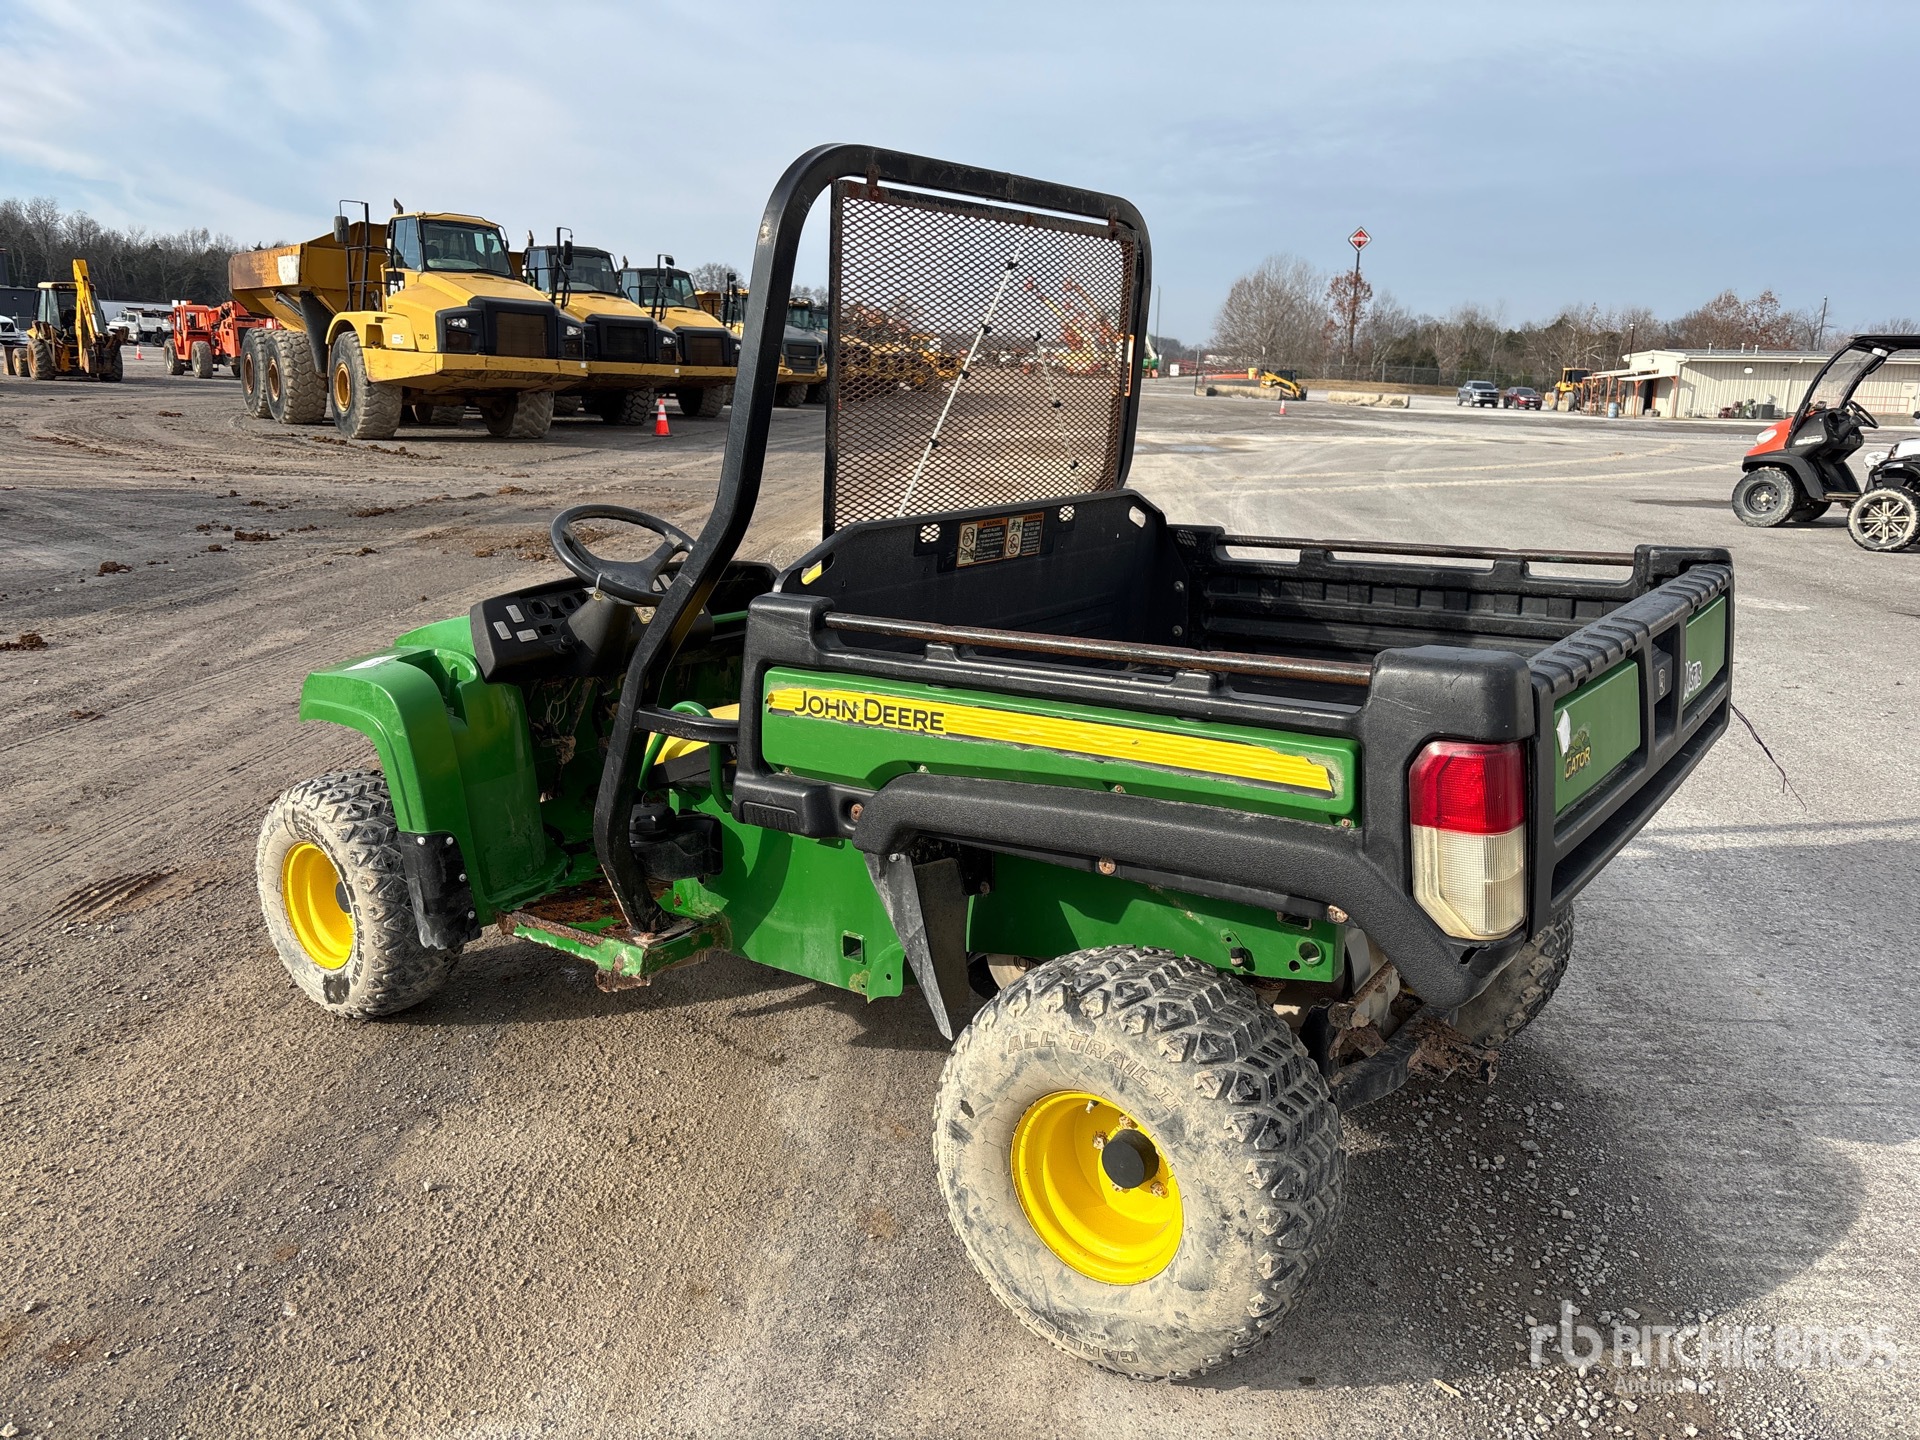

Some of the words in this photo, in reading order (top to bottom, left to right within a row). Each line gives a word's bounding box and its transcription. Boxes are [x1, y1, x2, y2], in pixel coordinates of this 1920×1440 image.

[795, 690, 858, 719] JOHN
[863, 698, 944, 731] DEERE
[1565, 746, 1591, 779] GATOR
[1007, 1030, 1056, 1055] ALL
[1068, 1032, 1151, 1088] TRAIL
[1004, 1290, 1139, 1364] CARLISLE
